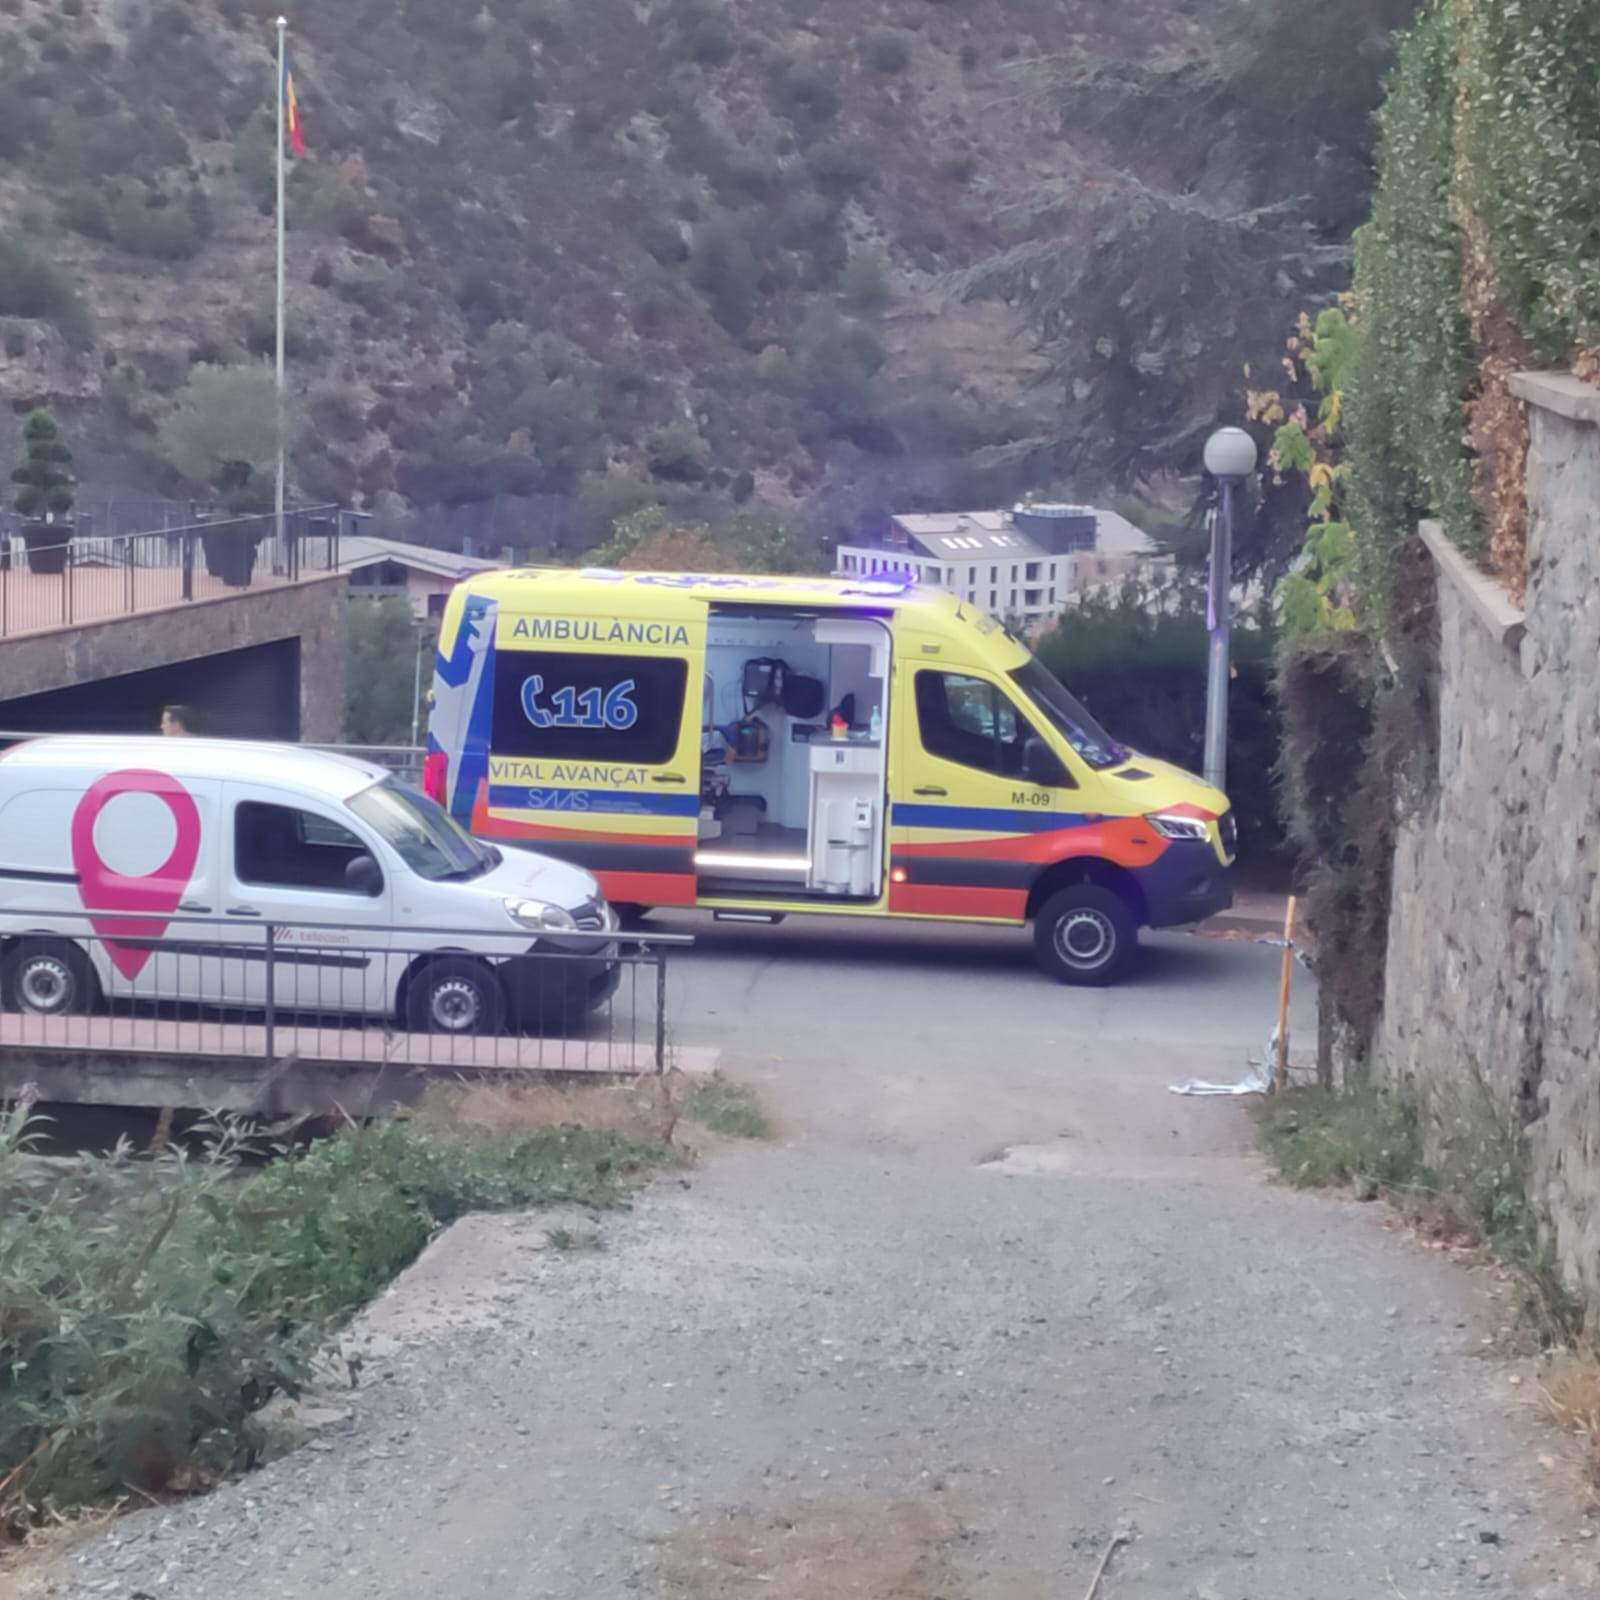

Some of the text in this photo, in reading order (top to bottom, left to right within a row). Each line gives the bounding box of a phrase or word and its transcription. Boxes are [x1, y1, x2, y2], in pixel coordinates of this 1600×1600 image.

[512, 617, 689, 645] AMBULÀNCIA
[551, 679, 638, 730] 116
[489, 762, 649, 788] VITAL AVANÇAT
[1011, 791, 1050, 806] M-09
